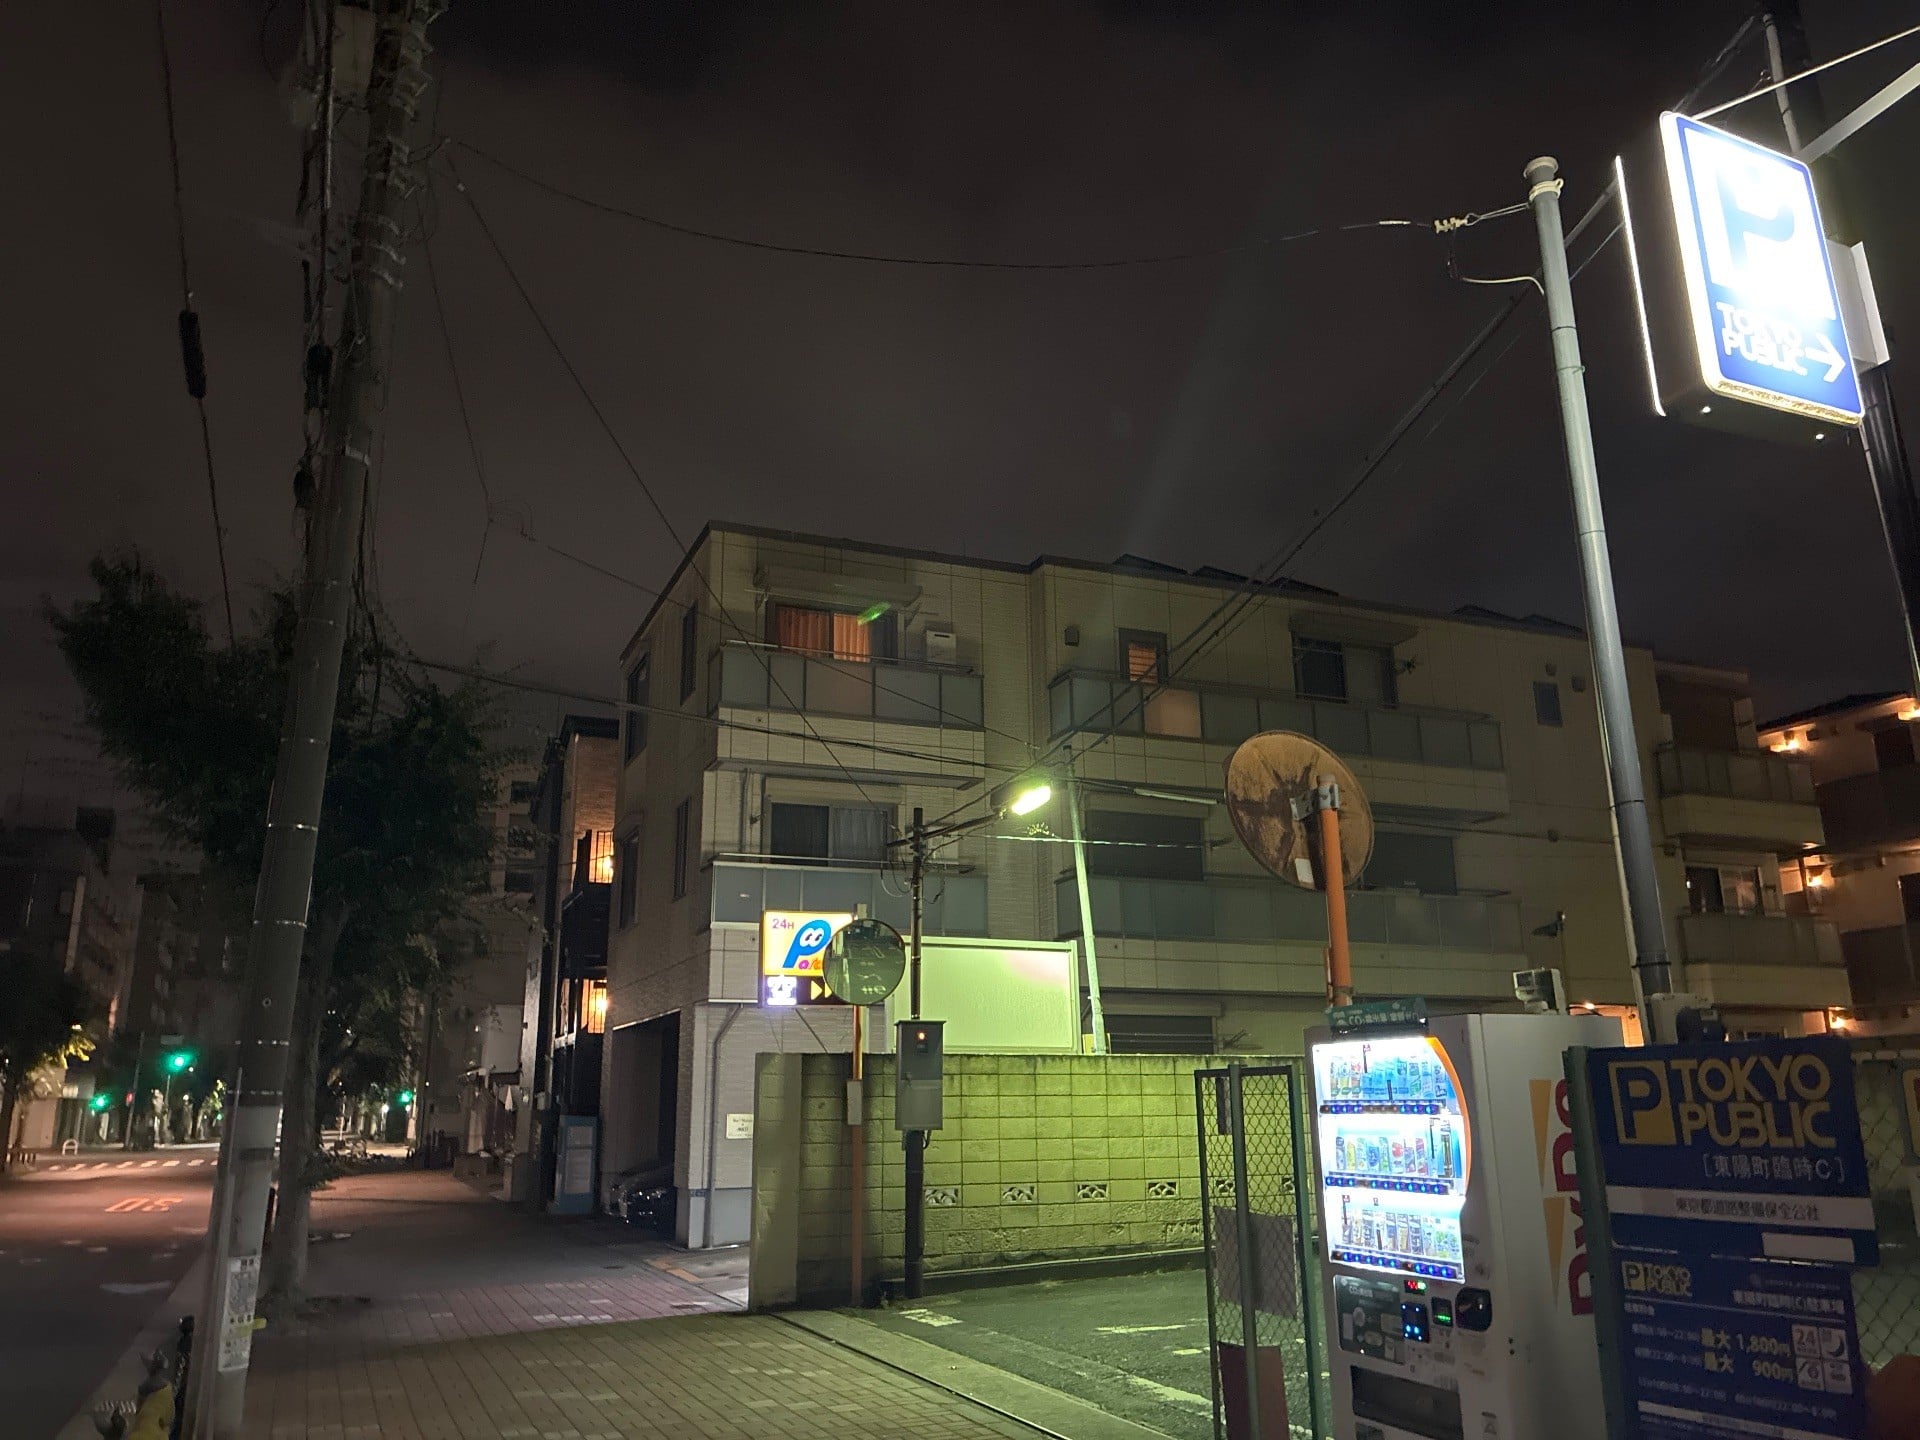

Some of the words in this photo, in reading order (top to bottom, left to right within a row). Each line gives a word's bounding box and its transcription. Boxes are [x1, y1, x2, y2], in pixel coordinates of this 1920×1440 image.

[1721, 328, 1809, 377] PUBLIC
[772, 918, 795, 930] 24H
[1670, 1053, 1832, 1102] TOKYO
[1677, 1101, 1837, 1149] PUBLIC
[1644, 1263, 1692, 1281] TOKYO
